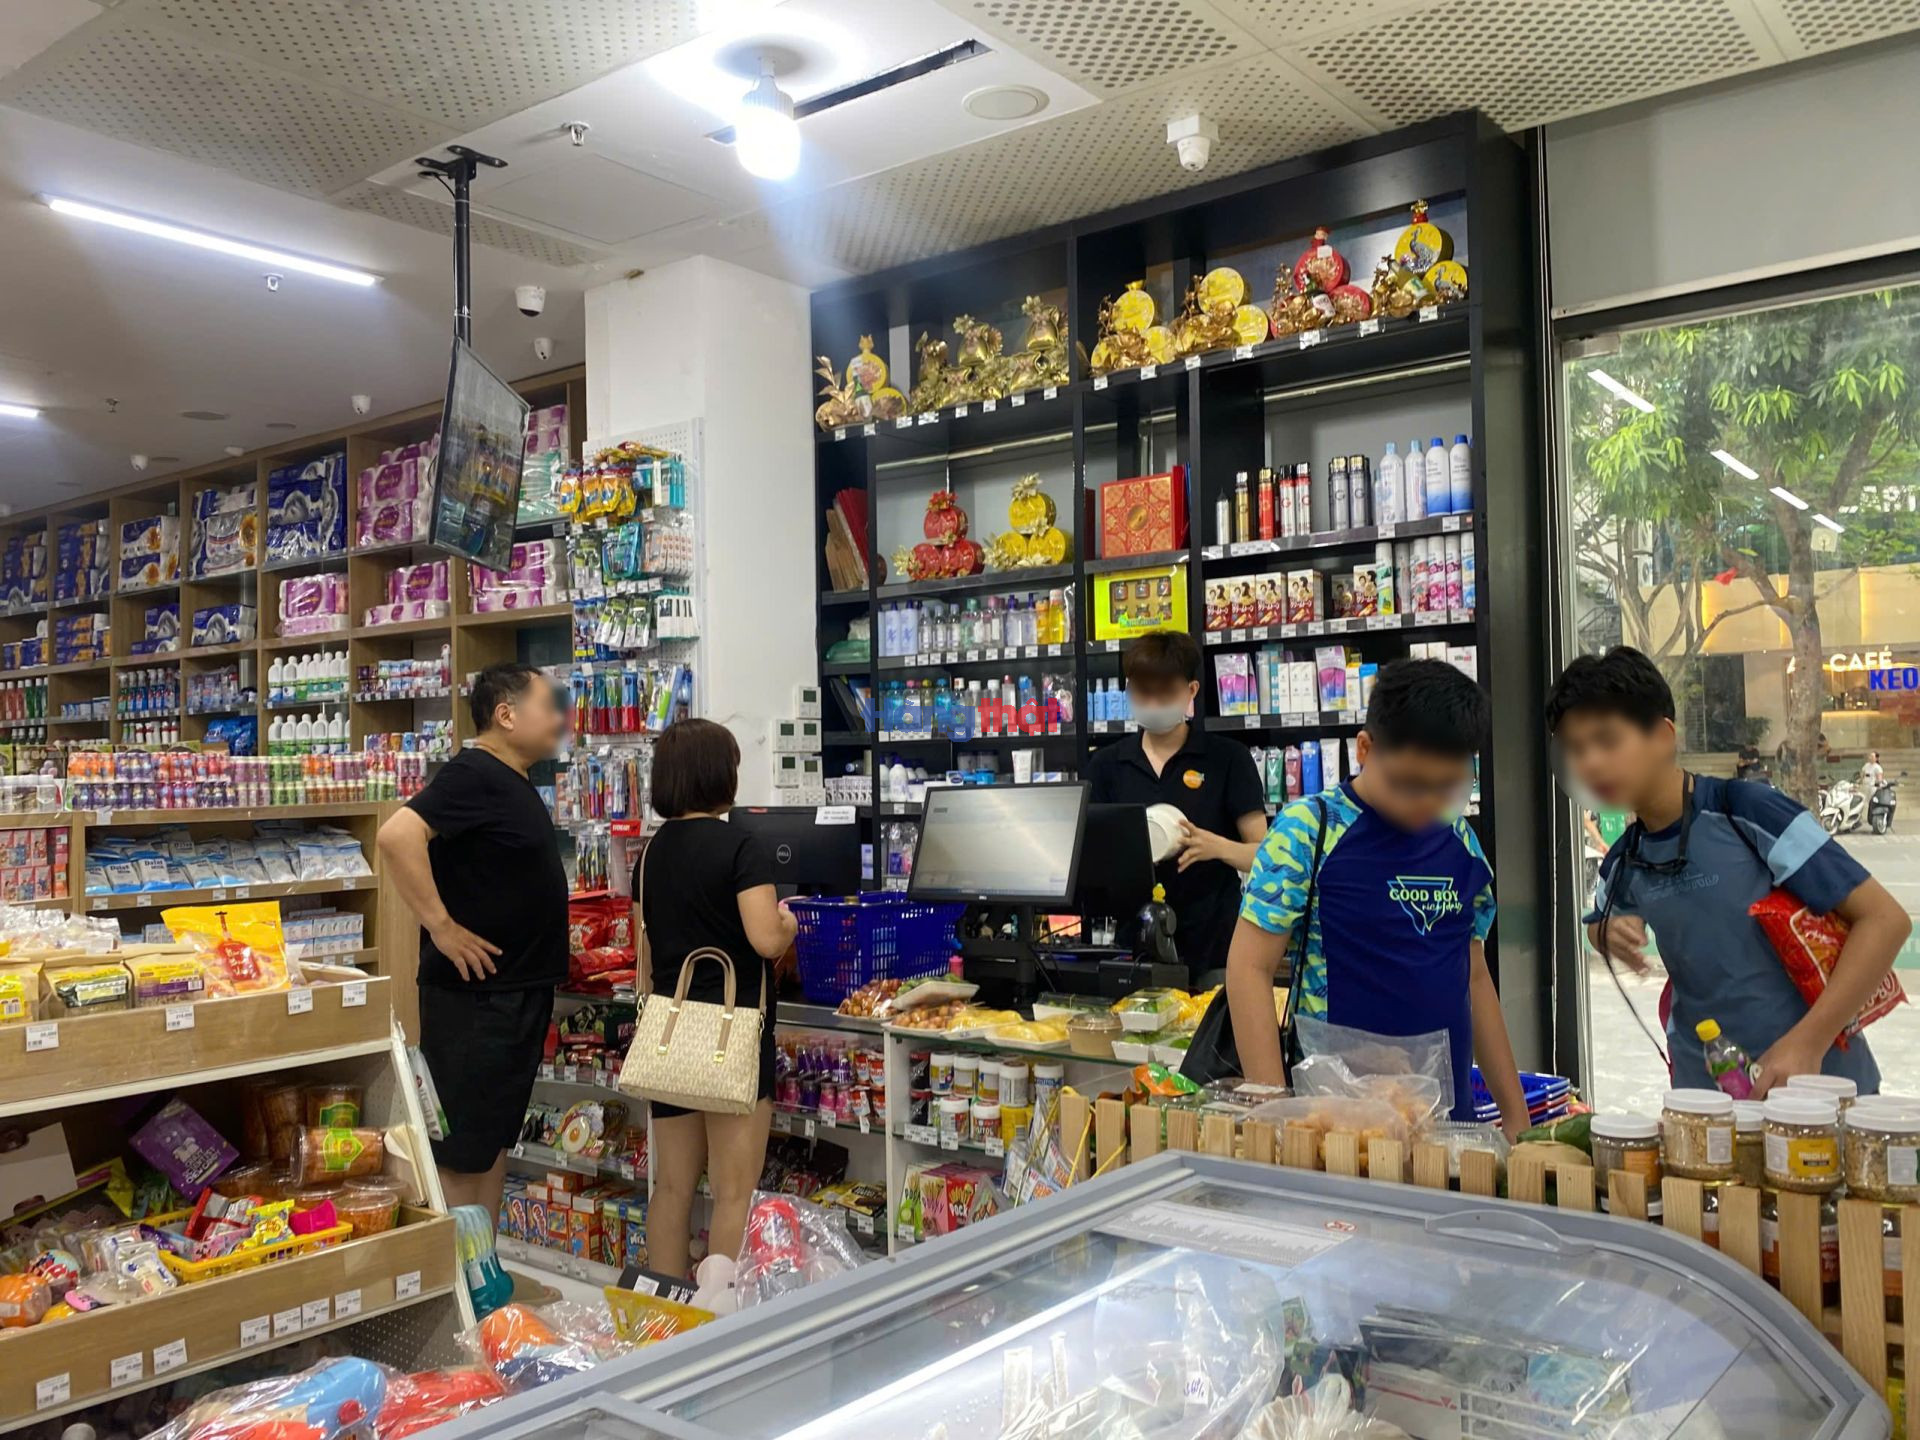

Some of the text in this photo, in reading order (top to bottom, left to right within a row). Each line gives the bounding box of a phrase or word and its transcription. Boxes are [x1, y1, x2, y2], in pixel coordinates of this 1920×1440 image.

[1829, 645, 1892, 672] CAFÉ
[1869, 667, 1919, 690] KEO
[1389, 888, 1459, 902] GOOD BOY
[949, 1202, 969, 1217] POCK
